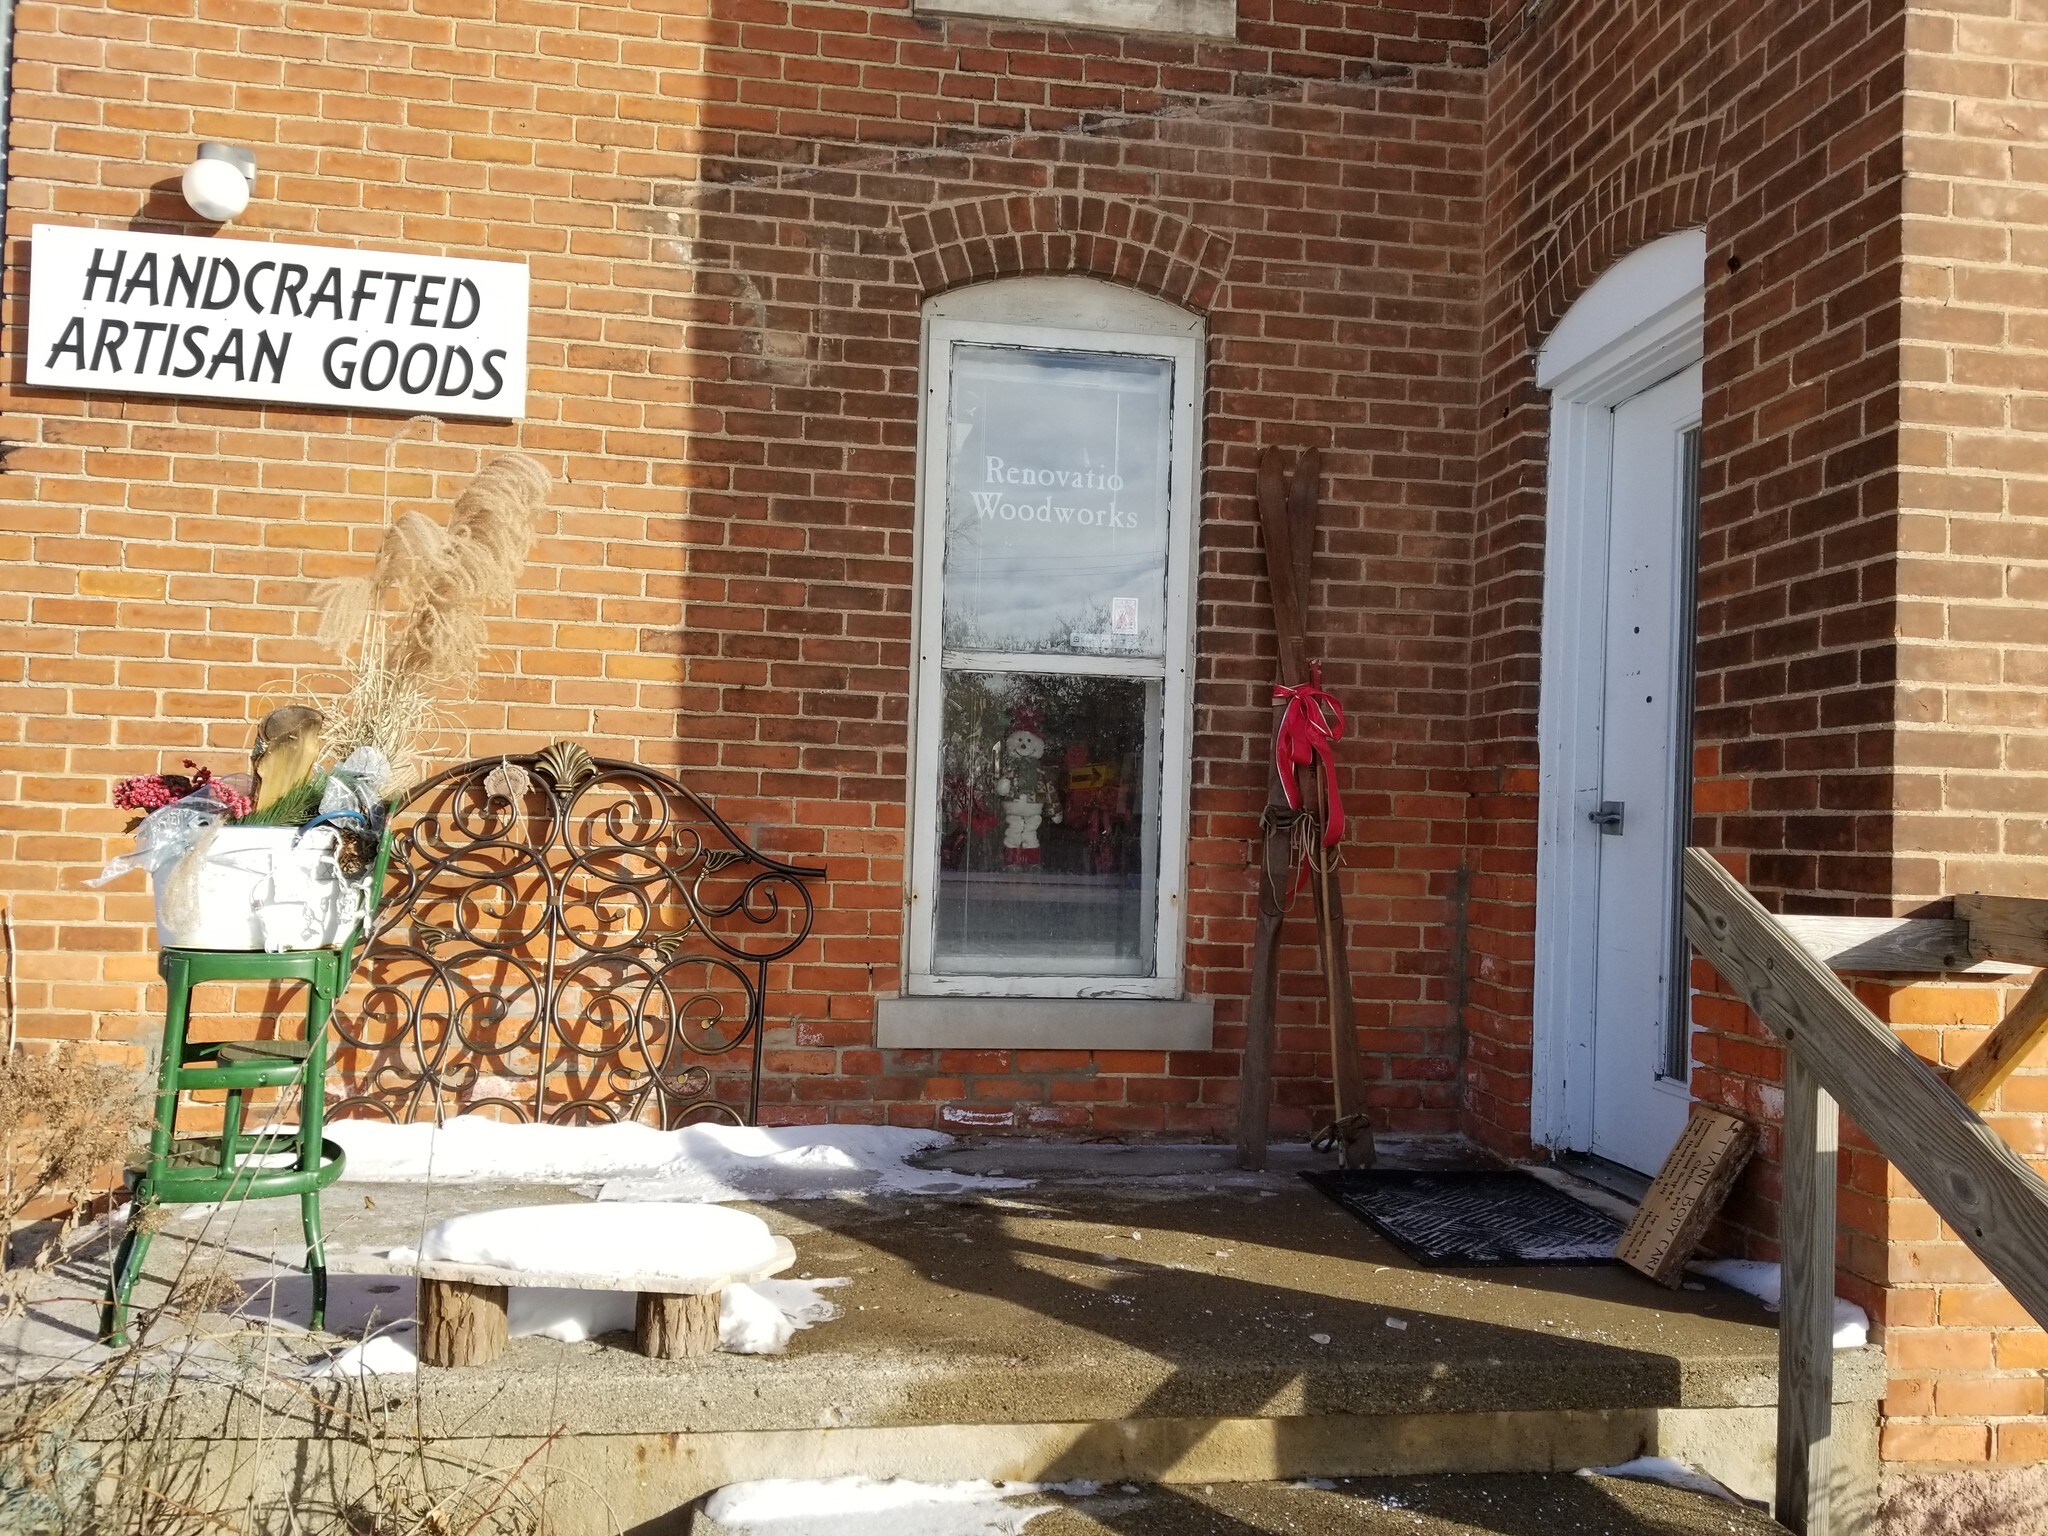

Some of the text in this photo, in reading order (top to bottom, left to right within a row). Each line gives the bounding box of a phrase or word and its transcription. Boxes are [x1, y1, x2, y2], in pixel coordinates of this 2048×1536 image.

[82, 247, 482, 331] HANDCRAFTED
[44, 316, 508, 401] ARTISAN GOODS
[970, 491, 1139, 529] Woodworks
[985, 455, 1124, 492] Renovatio
[1643, 1137, 1730, 1273] TIANI BODY CARE
